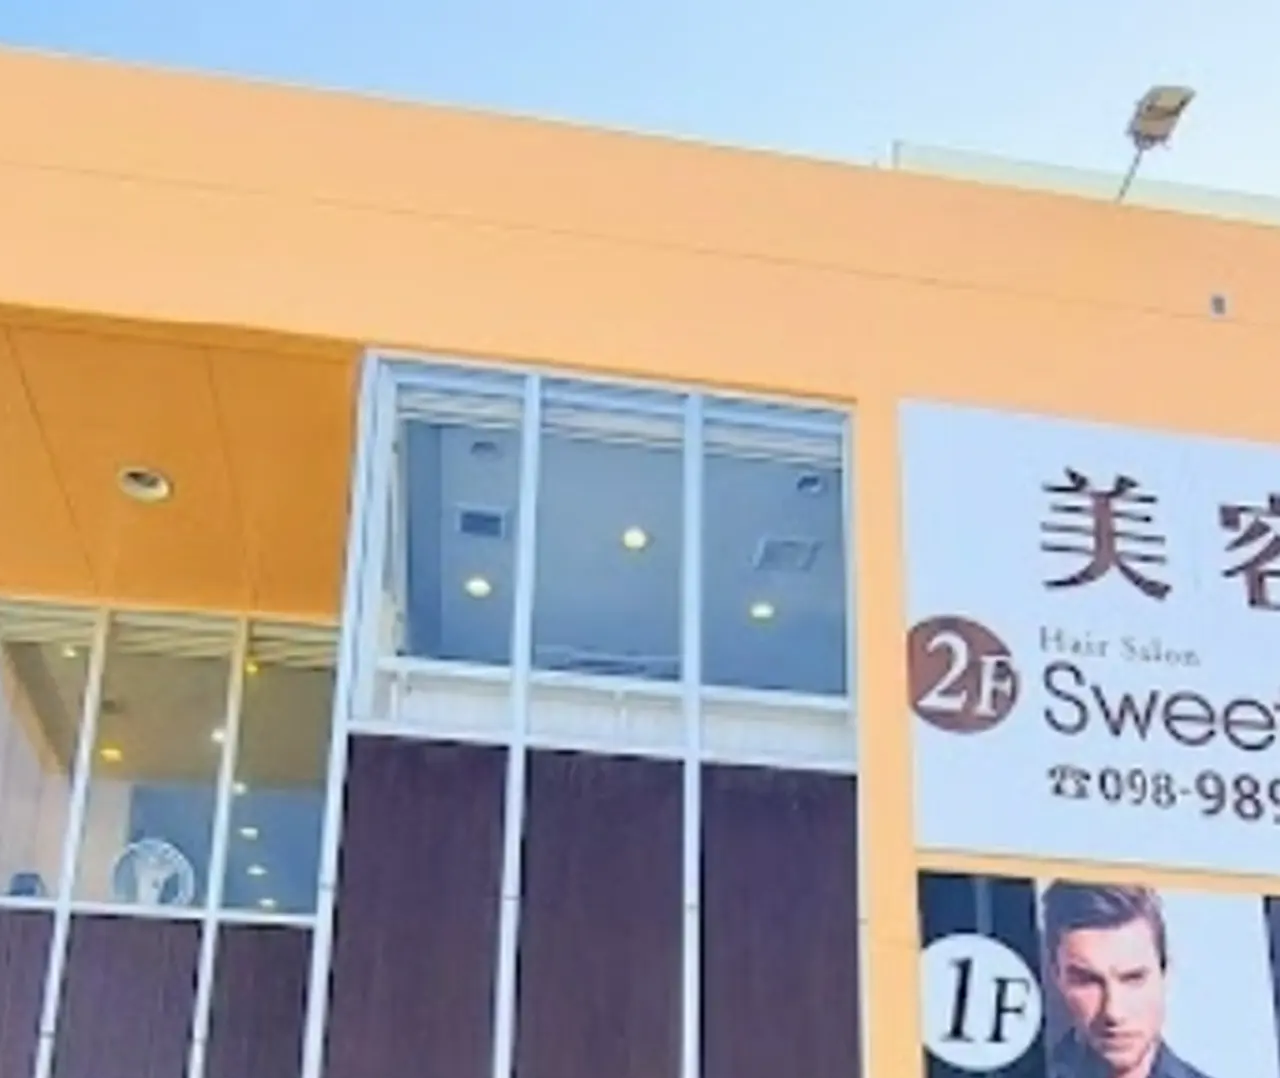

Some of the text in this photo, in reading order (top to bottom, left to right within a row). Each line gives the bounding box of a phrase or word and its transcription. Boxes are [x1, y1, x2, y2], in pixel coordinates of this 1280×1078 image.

[916, 630, 1014, 718] 2F
[1038, 626, 1201, 668] Hair Salon
[941, 956, 1031, 1044] 1F
